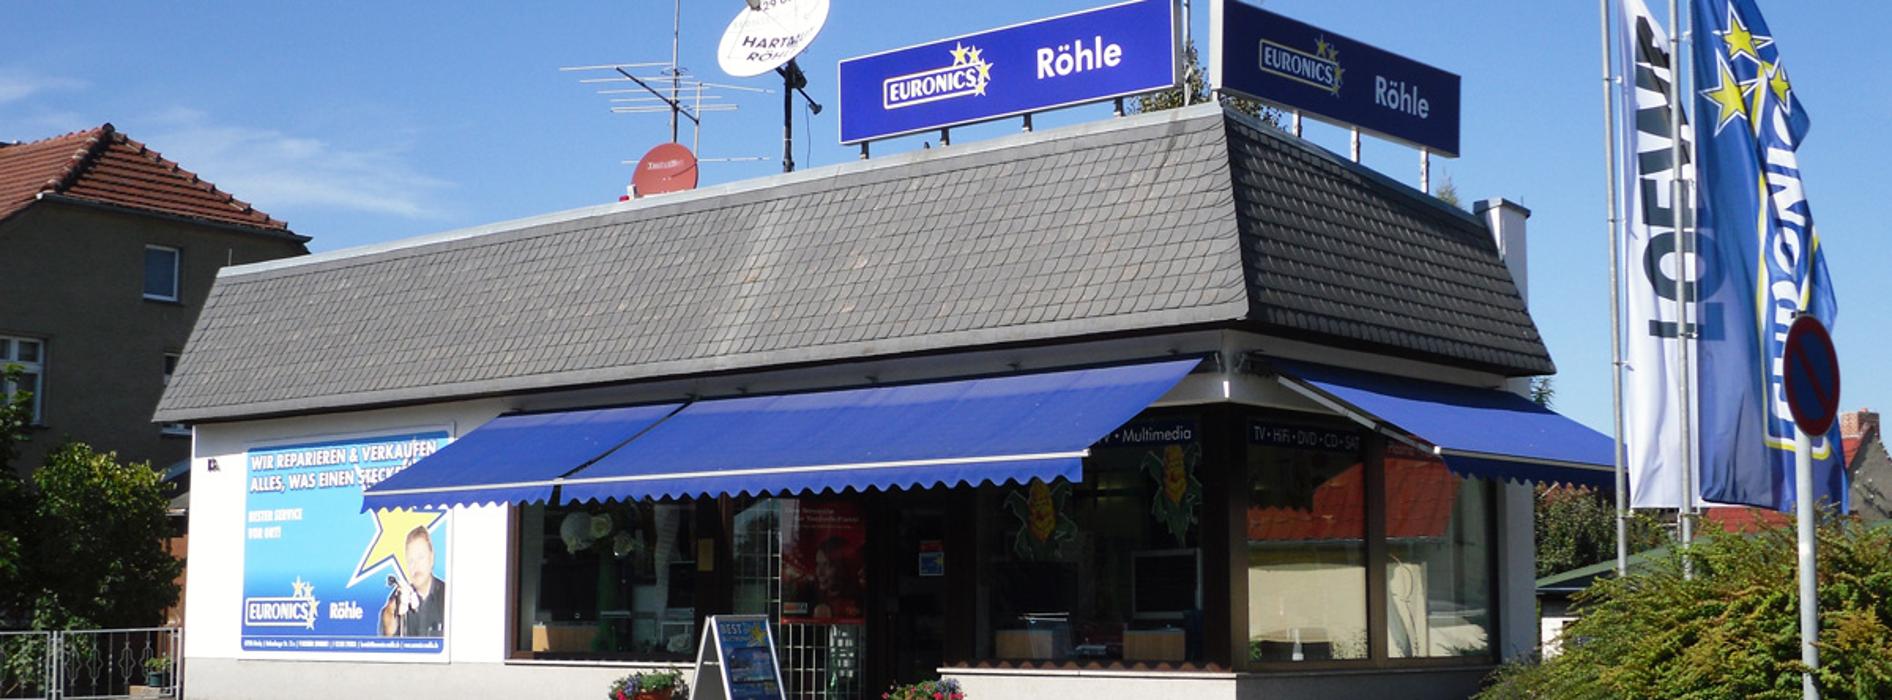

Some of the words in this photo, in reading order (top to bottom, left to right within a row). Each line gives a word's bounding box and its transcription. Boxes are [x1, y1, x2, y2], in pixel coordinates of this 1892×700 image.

[1037, 36, 1122, 79] Röhle
[1264, 46, 1334, 86] EURONICS
[890, 68, 976, 102] EURONICS
[1375, 75, 1430, 119] Röhle
[1122, 425, 1192, 443] Multimedia
[1253, 425, 1266, 441] TV
[1297, 430, 1318, 446] DVD
[1324, 432, 1338, 448] CD
[1344, 435, 1361, 450] SAT
[251, 454, 274, 471] WIR
[277, 448, 346, 470] REPARIEREN
[349, 446, 359, 464] &
[361, 440, 437, 462] VERKAUFEN
[250, 475, 286, 494] ALLES,
[288, 473, 317, 490] WAS
[319, 469, 354, 489] EINEN
[249, 602, 309, 620] EURONICS
[329, 600, 364, 620] Röhle
